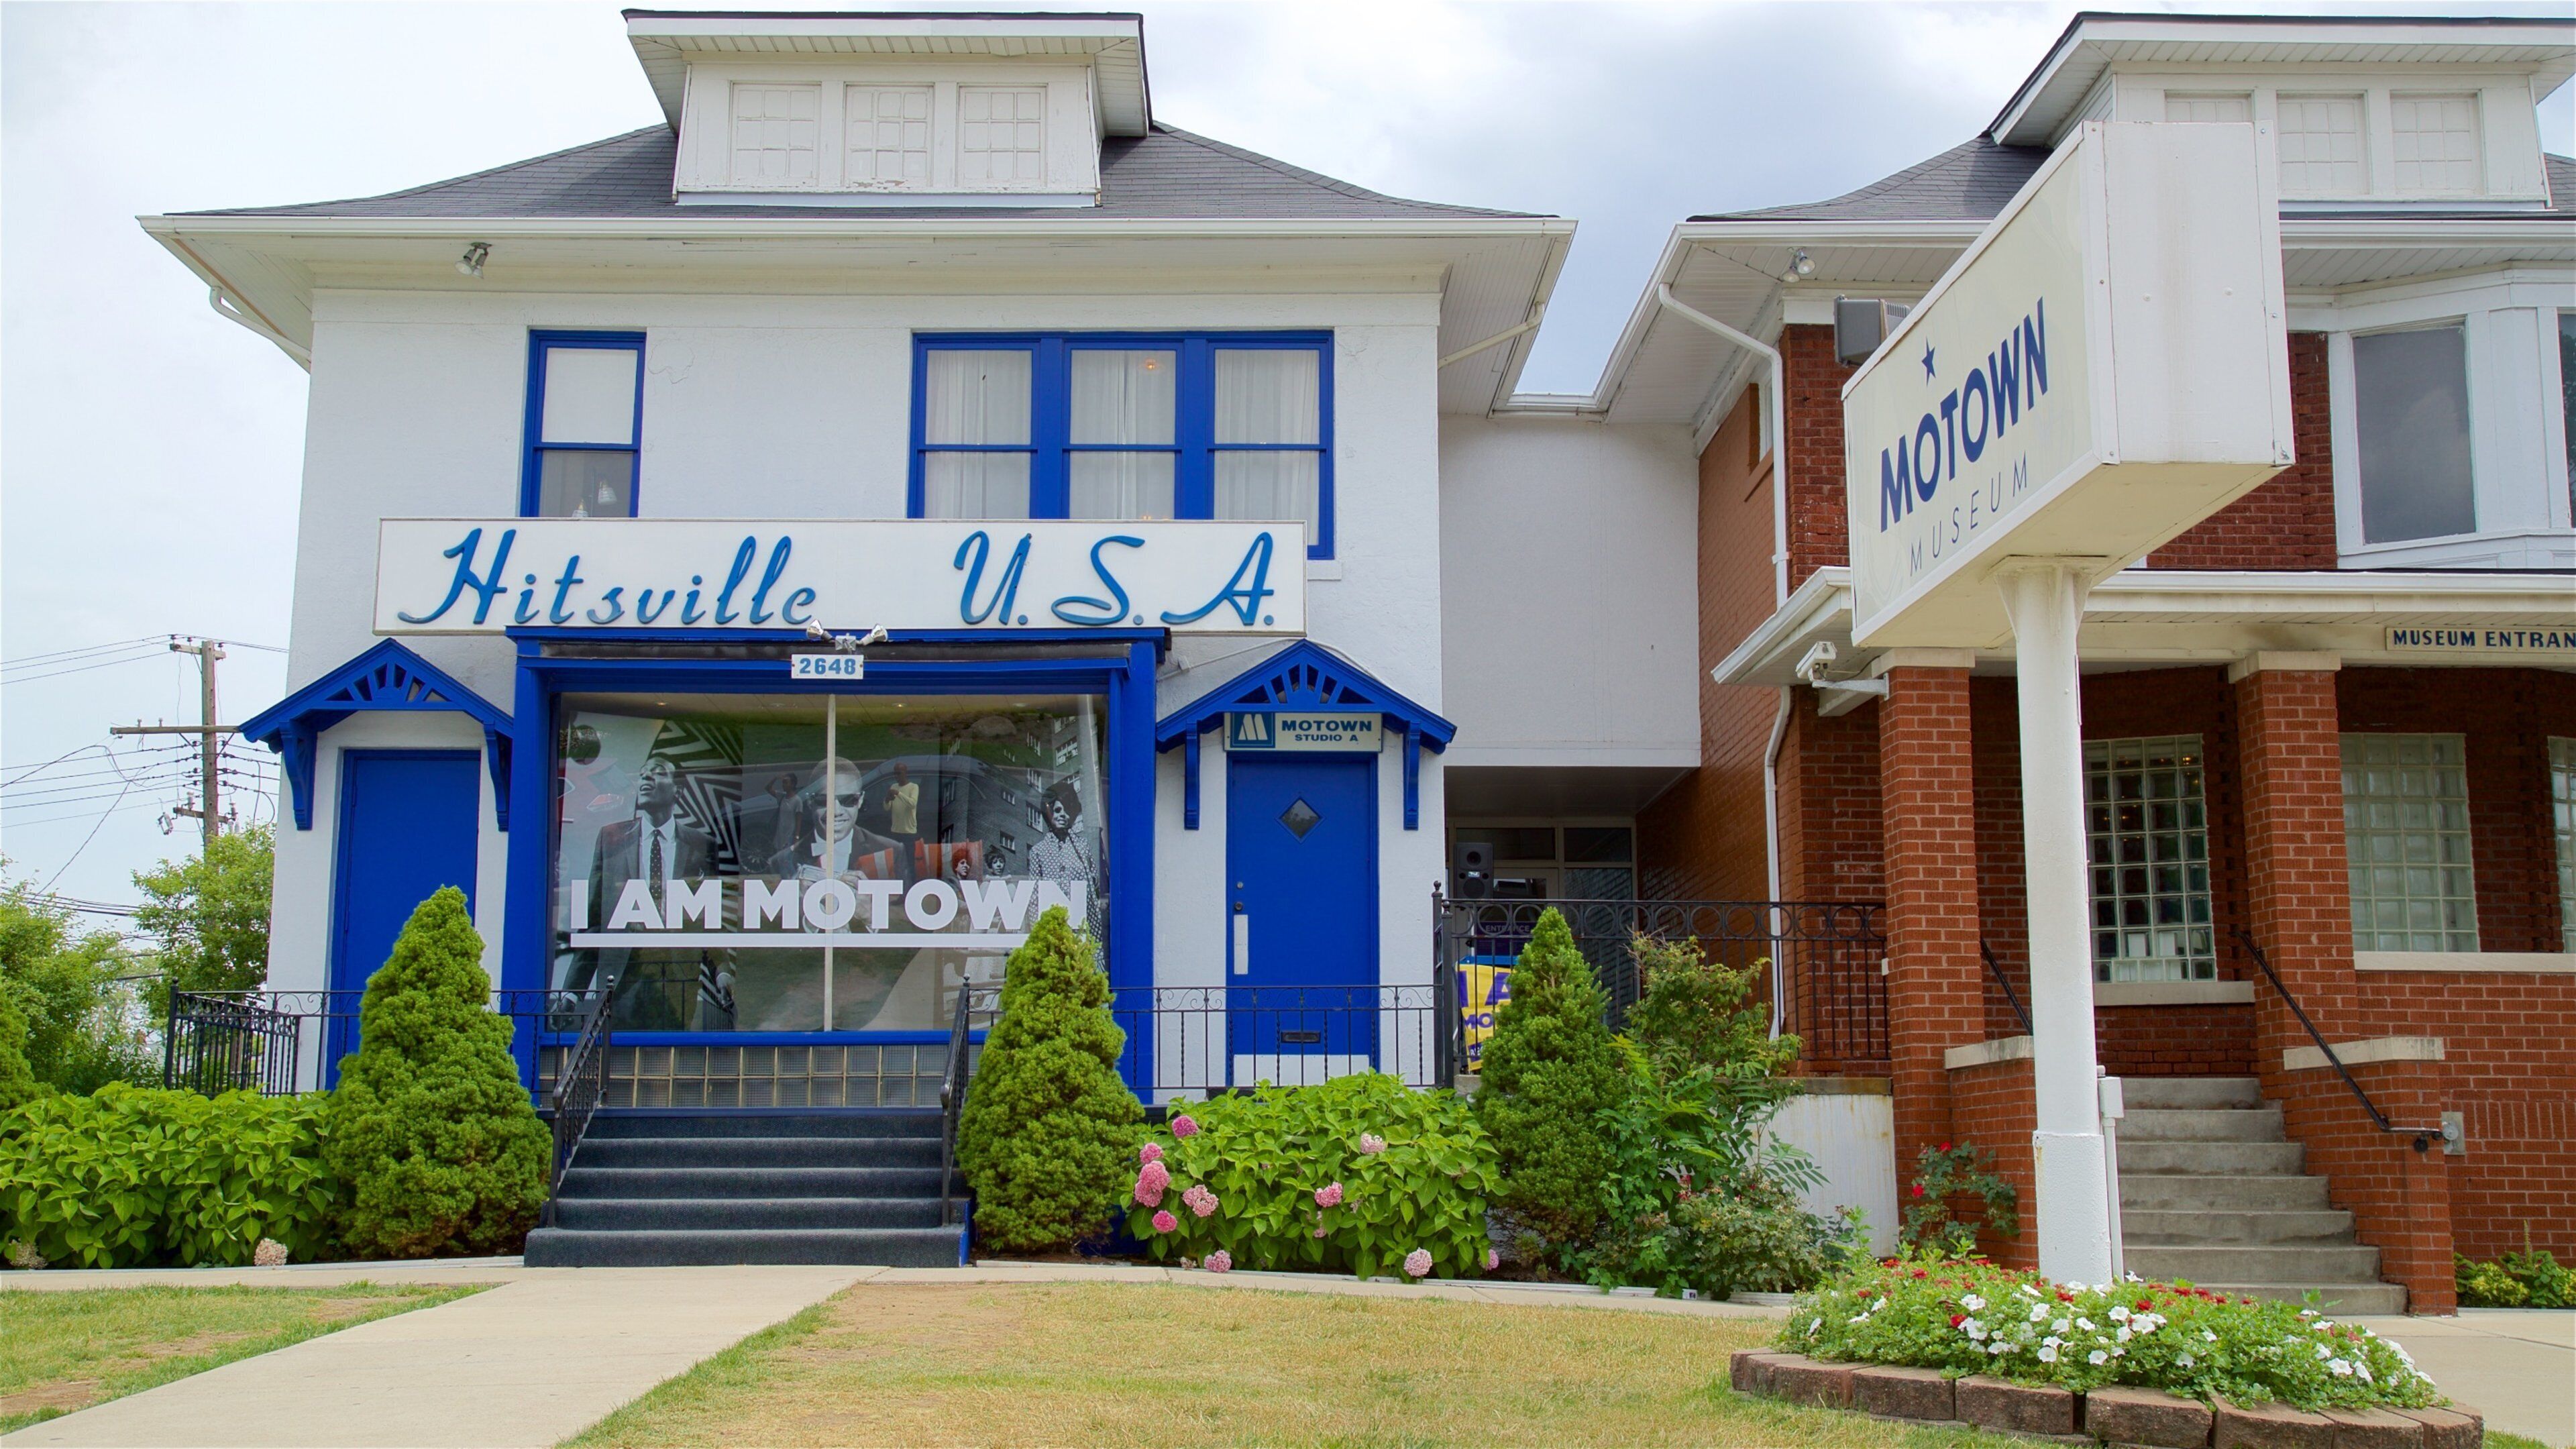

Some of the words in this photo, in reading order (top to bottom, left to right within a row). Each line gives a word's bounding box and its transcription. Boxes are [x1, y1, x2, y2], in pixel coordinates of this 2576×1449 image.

[1881, 296, 2048, 533] MOTOWN
[1910, 451, 2027, 577] MUSEUM
[398, 530, 816, 627] Hitsville
[2393, 630, 2475, 647] MUSEUM
[799, 657, 856, 675] 2648
[1281, 720, 1372, 732] MOTOWN
[1294, 733, 1343, 742] STUDIO
[1349, 734, 1359, 742] A
[571, 879, 588, 929] I
[607, 879, 722, 929] AM
[743, 879, 1087, 930] MOTOWN
